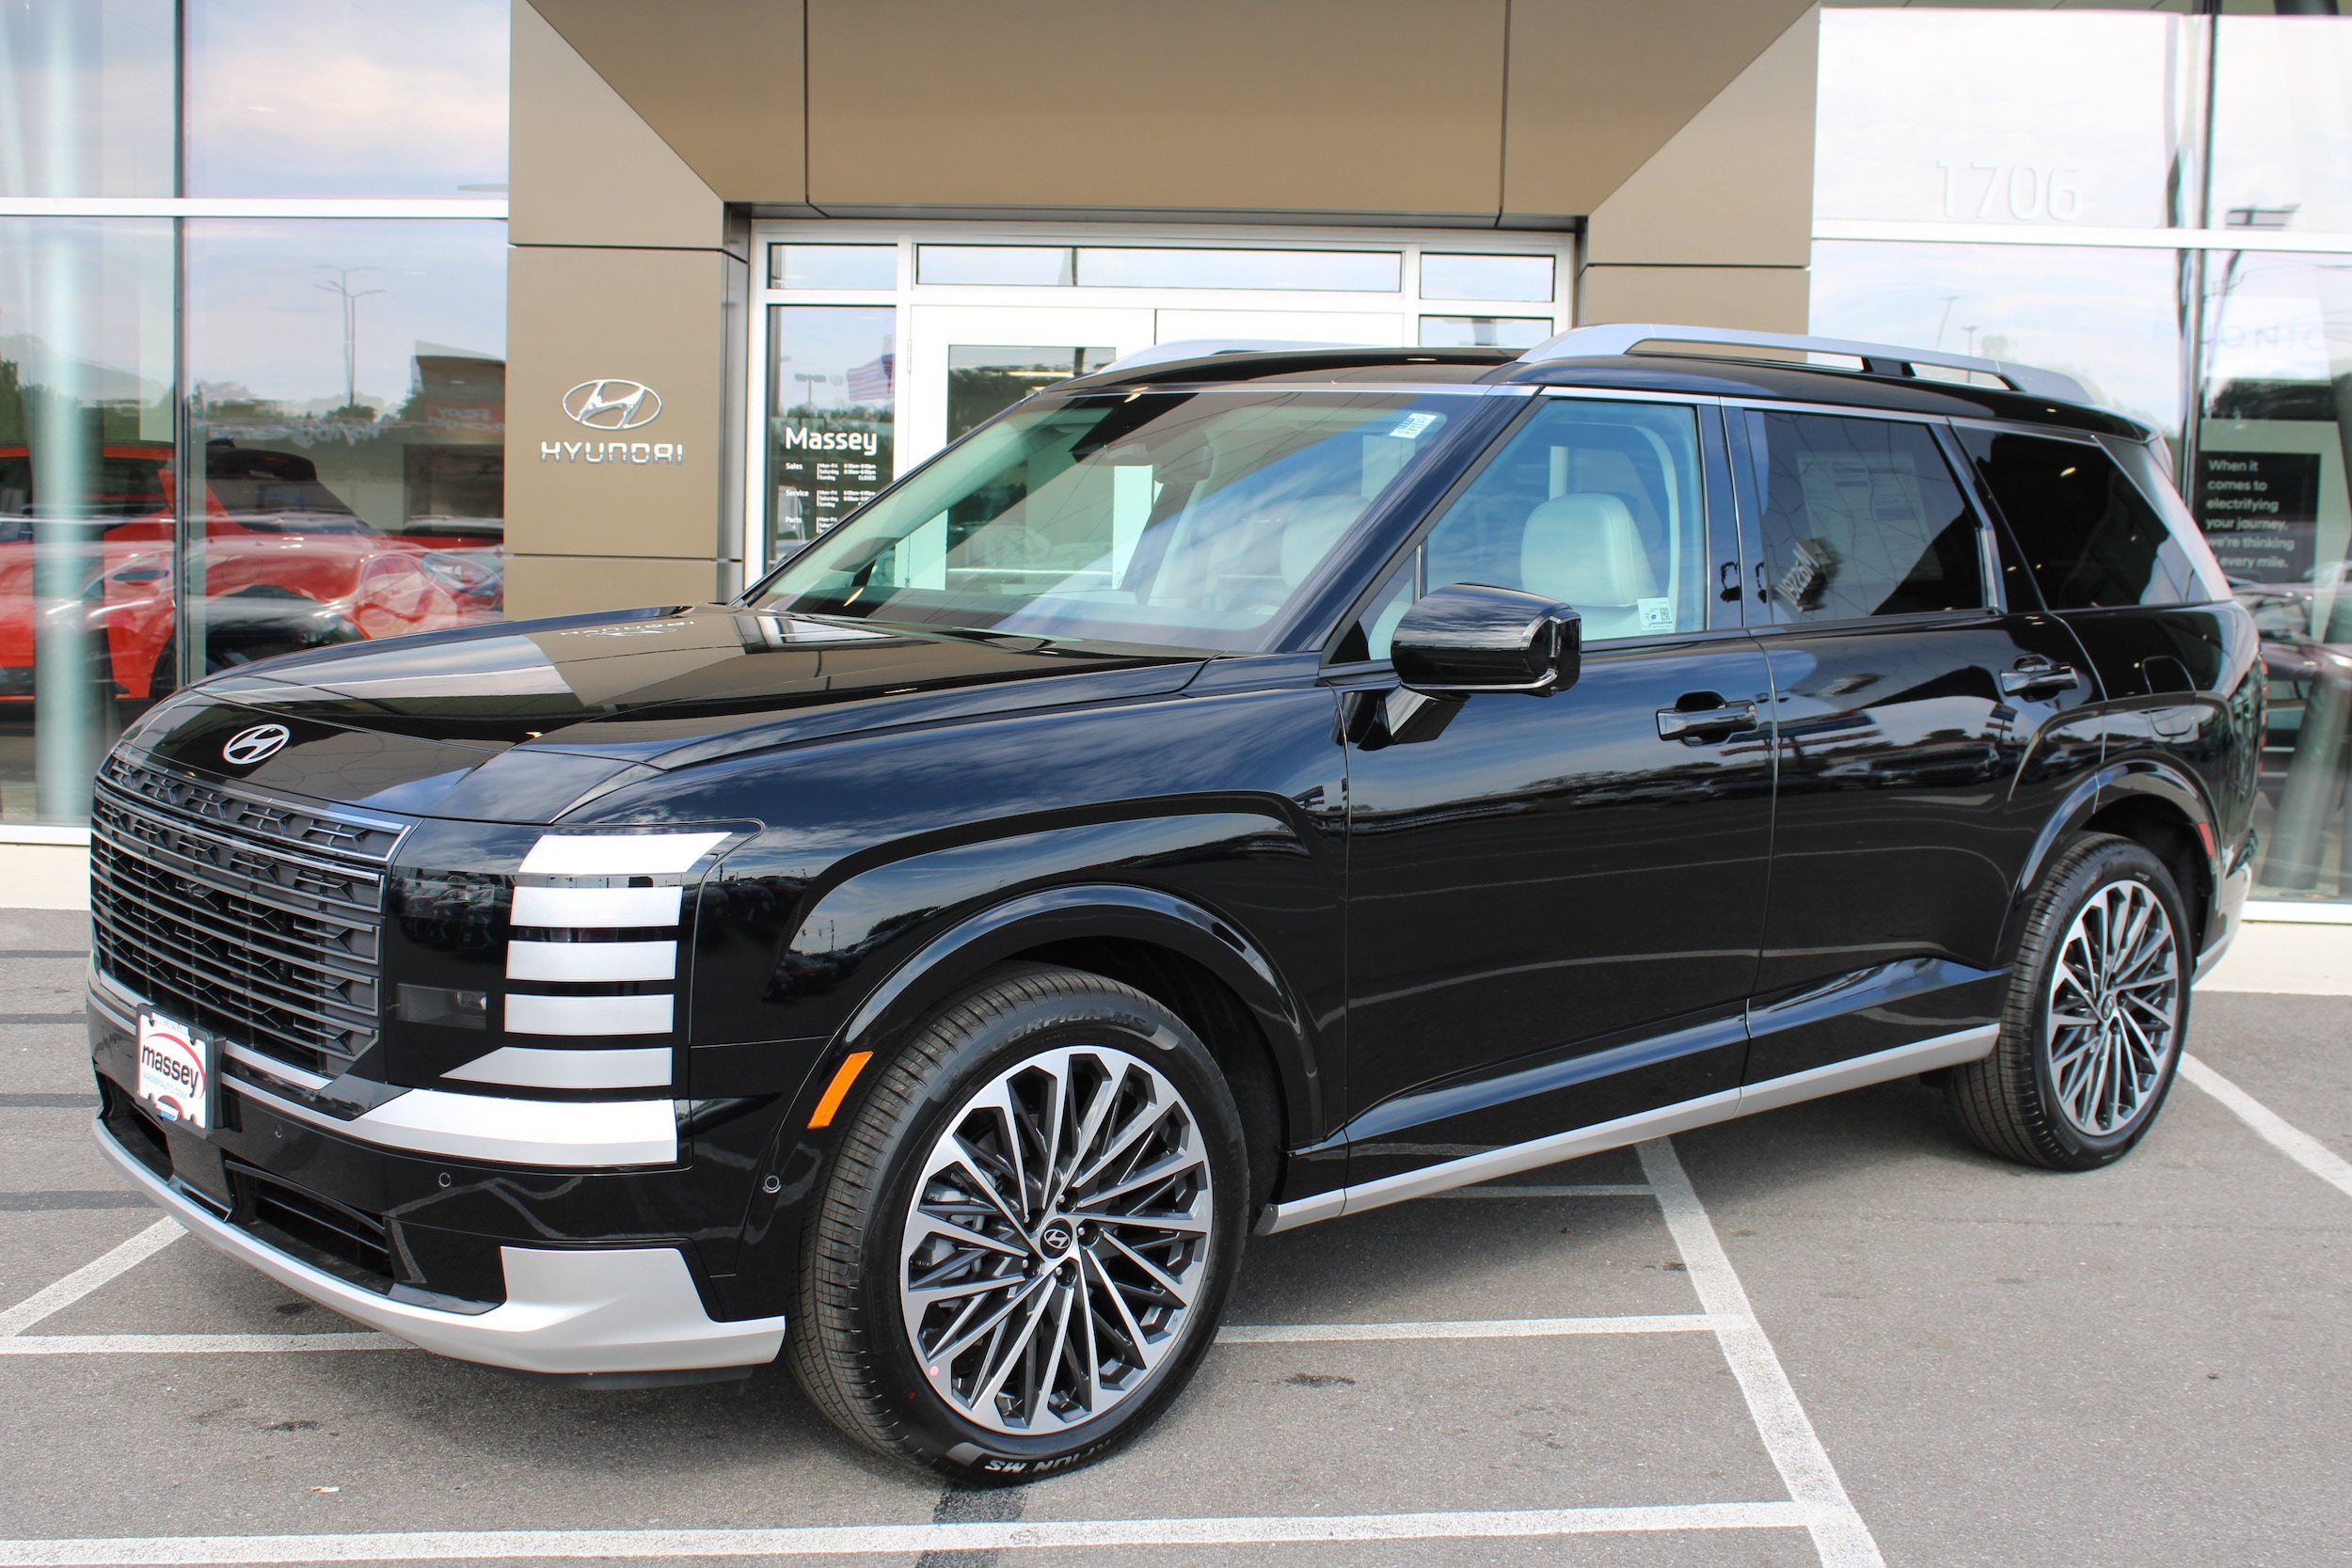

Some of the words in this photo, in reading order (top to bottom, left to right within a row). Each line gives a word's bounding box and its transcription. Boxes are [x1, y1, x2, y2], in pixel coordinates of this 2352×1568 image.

[1935, 160, 2083, 222] 1706
[785, 427, 878, 456] Massey
[540, 440, 683, 465] HYUNDAI
[2207, 459, 2247, 471] When
[2249, 459, 2259, 472] it
[2206, 481, 2251, 491] comes
[2253, 481, 2267, 492] to
[2205, 498, 2280, 514] electrifying
[2205, 518, 2235, 530] your
[2236, 517, 2289, 531] journey,
[2206, 536, 2241, 547] we're
[2242, 536, 2296, 552] thinking
[2219, 557, 2256, 570] every
[2257, 555, 2289, 568] mile.
[141, 1044, 199, 1099] massey
[984, 1459, 1027, 1474] MS
